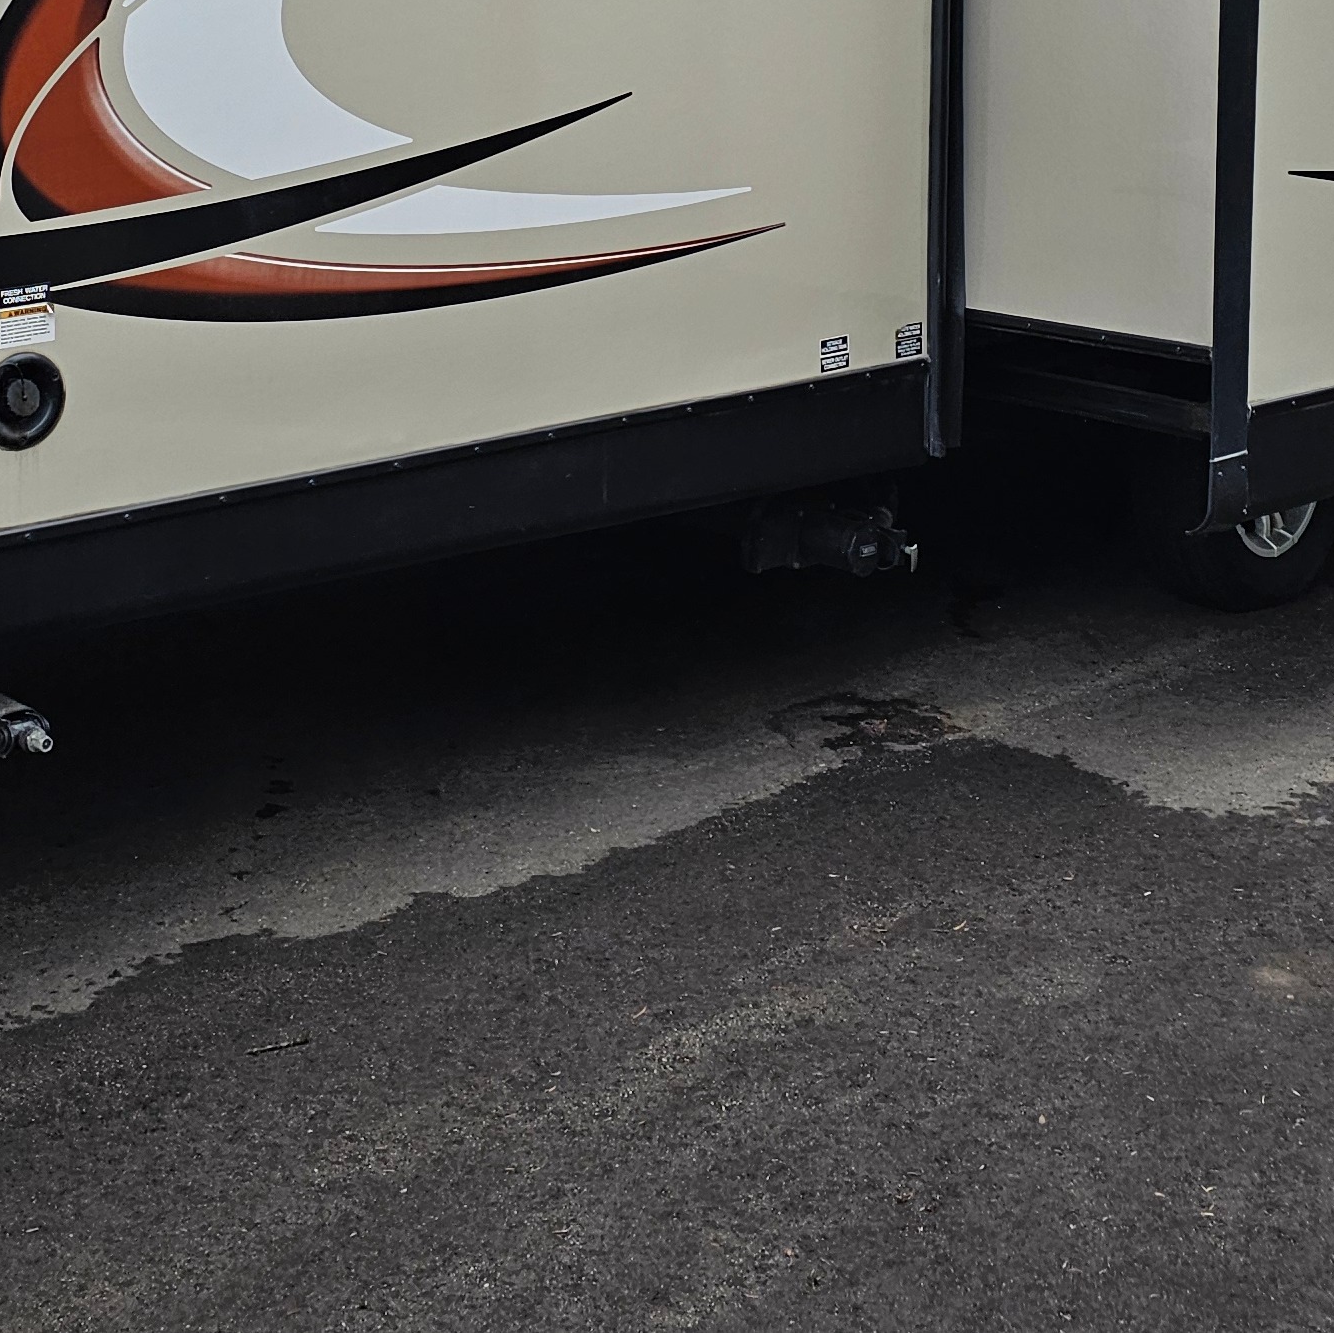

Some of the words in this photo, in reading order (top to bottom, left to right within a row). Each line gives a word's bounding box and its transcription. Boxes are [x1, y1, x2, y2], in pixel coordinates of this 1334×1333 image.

[0, 288, 23, 298] FRESH
[25, 284, 48, 294] WATER
[3, 292, 46, 304] CONNECTION
